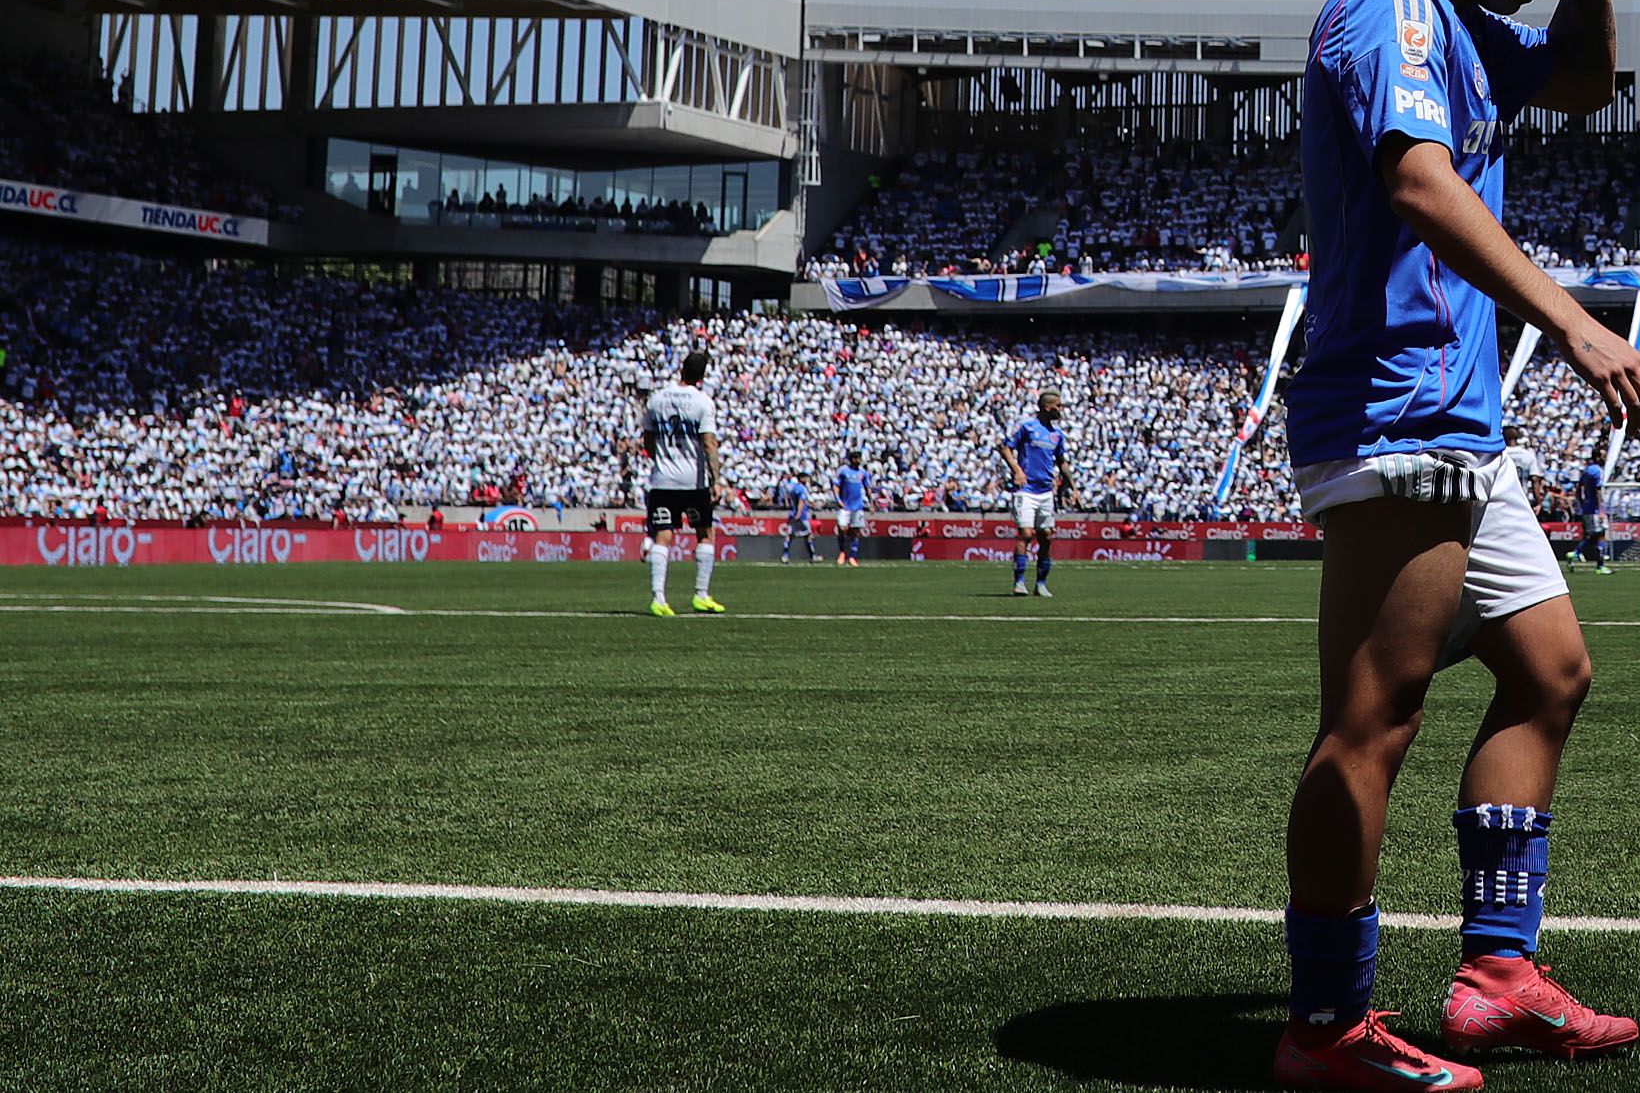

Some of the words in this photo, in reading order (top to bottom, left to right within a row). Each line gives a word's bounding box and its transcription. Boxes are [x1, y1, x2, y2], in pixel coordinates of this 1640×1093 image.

[0, 184, 78, 214] DAUC.CL
[141, 206, 240, 237] TIENDAUC.CL
[208, 526, 291, 564] Claro
[355, 528, 429, 562] Claro
[943, 524, 978, 538] Claro
[1206, 528, 1242, 539] Claro
[1263, 528, 1299, 540] Claro
[37, 526, 136, 567] Claro
